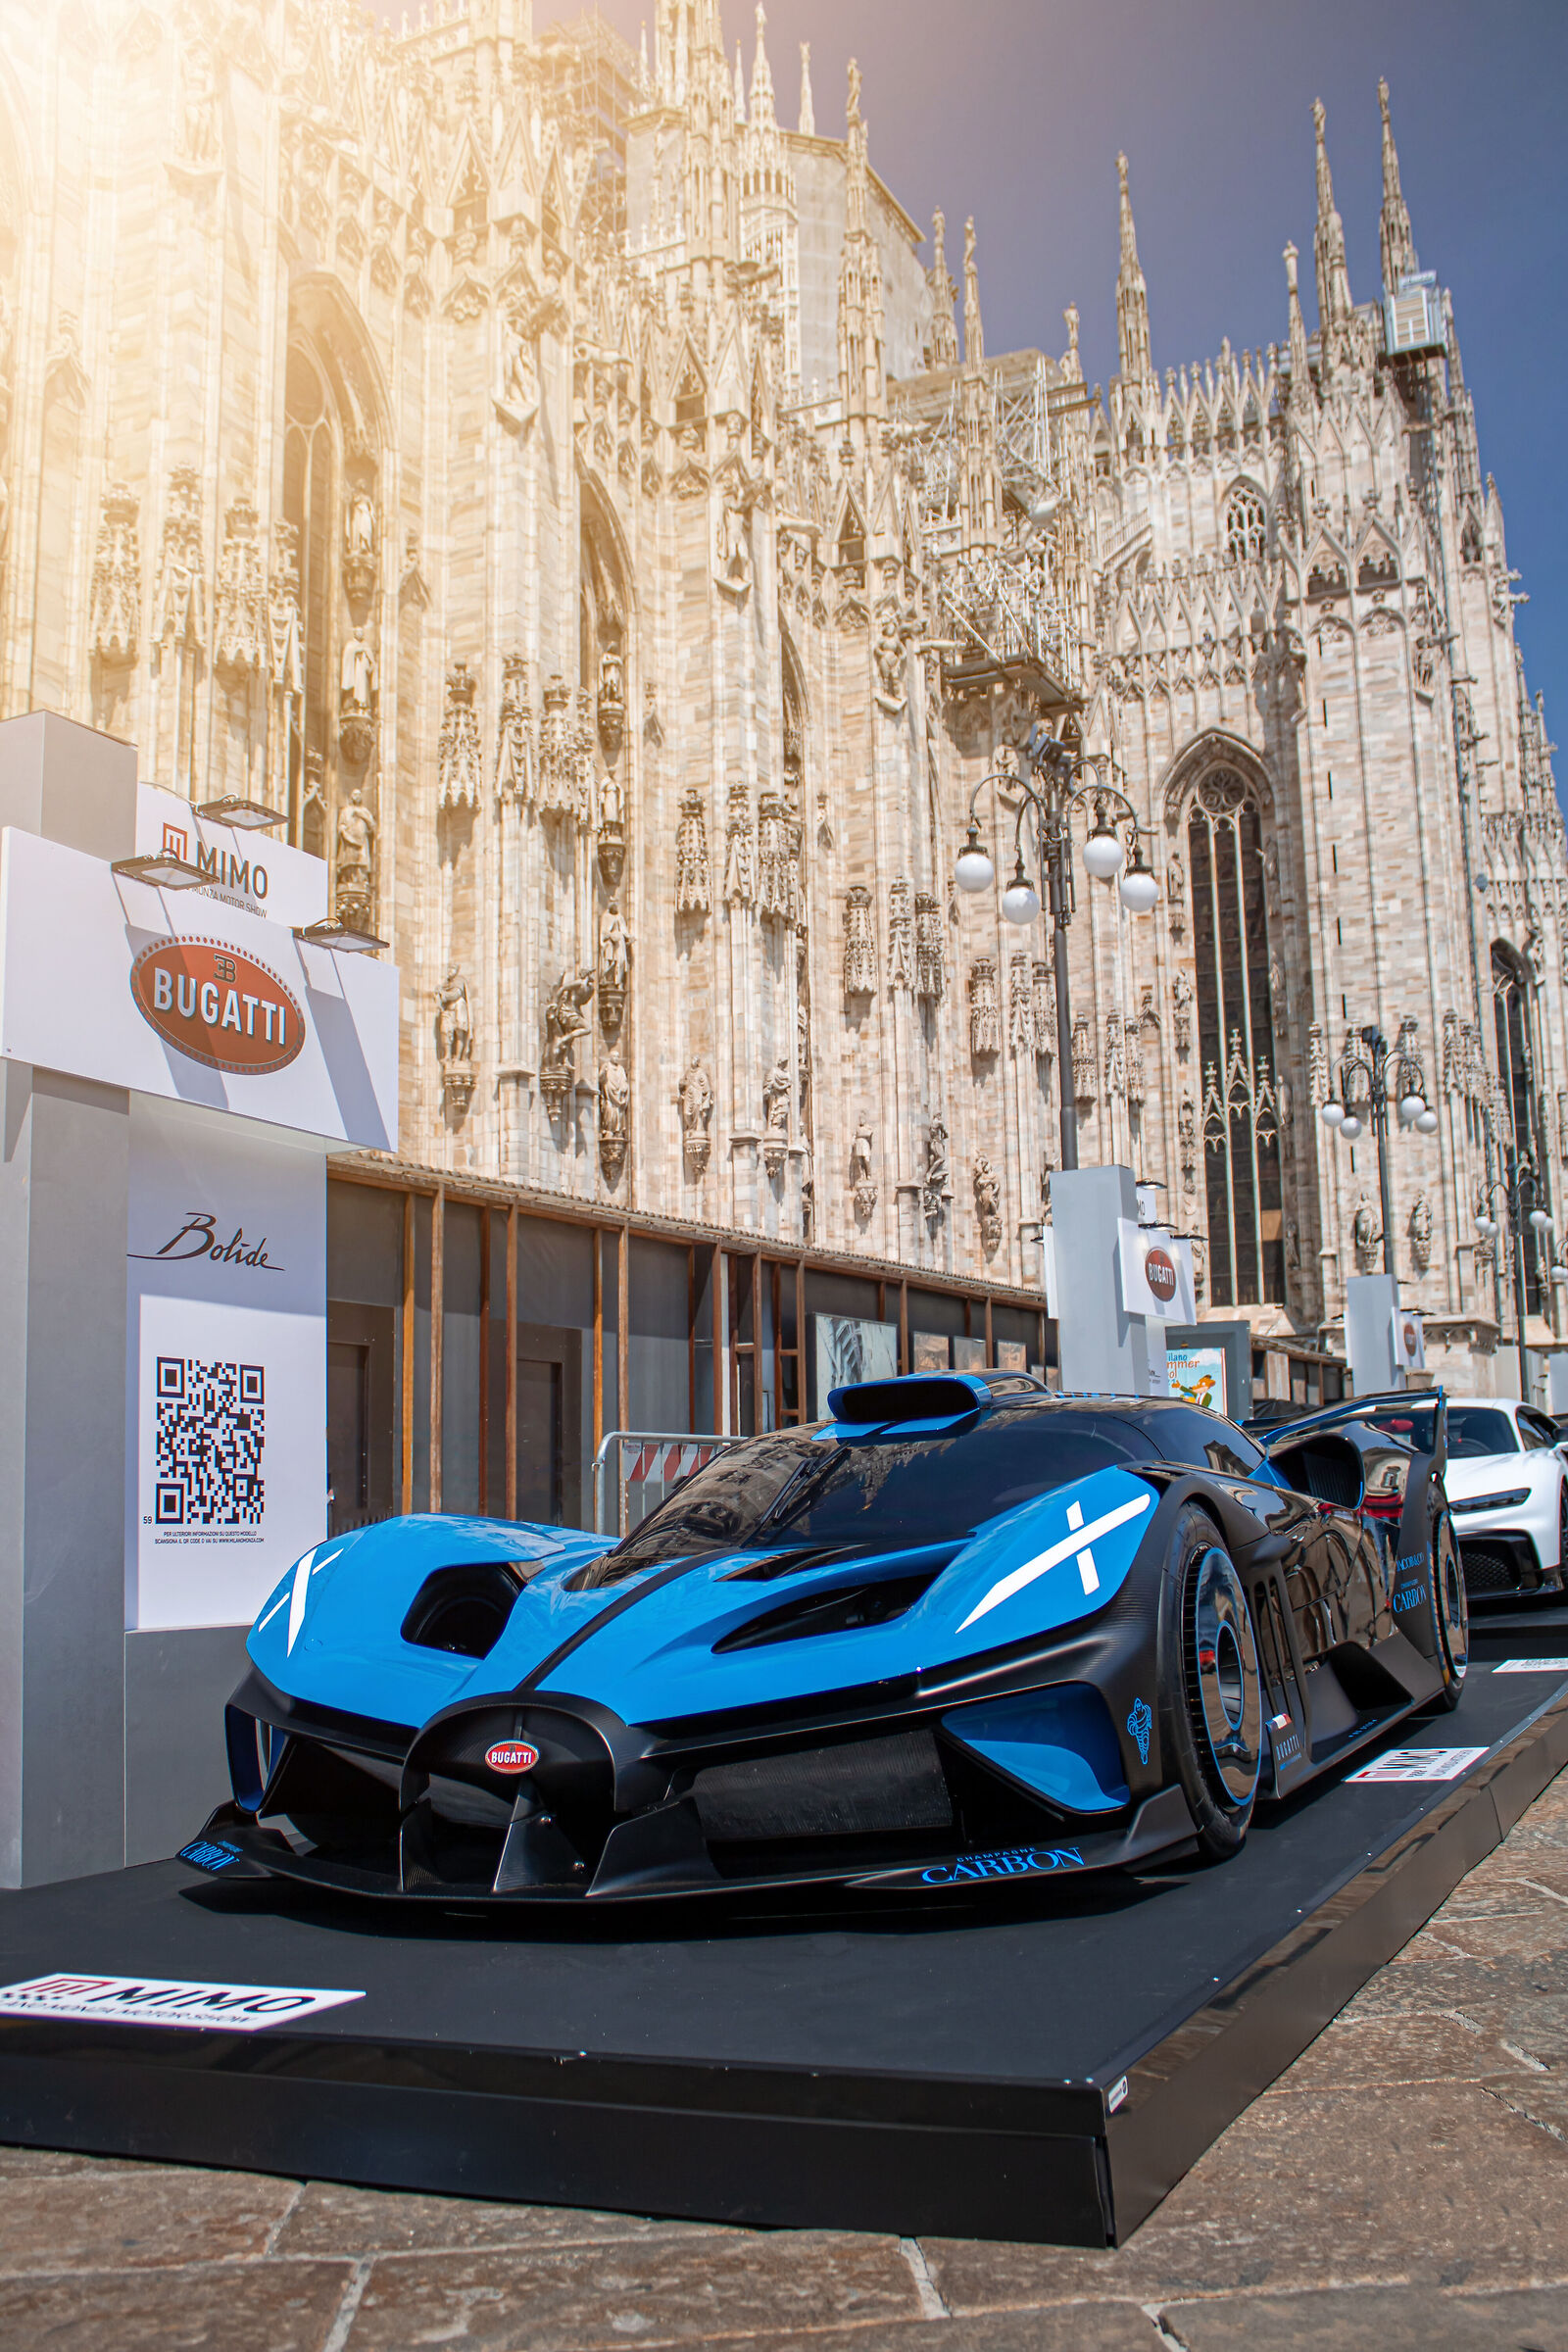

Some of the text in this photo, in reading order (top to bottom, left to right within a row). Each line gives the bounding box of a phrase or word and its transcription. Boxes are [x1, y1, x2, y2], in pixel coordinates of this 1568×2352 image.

[197, 841, 269, 900] MIMO
[220, 893, 245, 911] MOTOR
[245, 903, 268, 918] SHOW
[154, 966, 286, 1046] BUGATTI
[125, 1211, 287, 1272] Bolide
[1148, 1262, 1174, 1287] BUGATTI
[491, 1751, 532, 1764] BUGATTI
[921, 1846, 1086, 1884] CARBON
[956, 1847, 1038, 1863] CHAMPAGNE
[84, 1985, 317, 2013] MIMO
